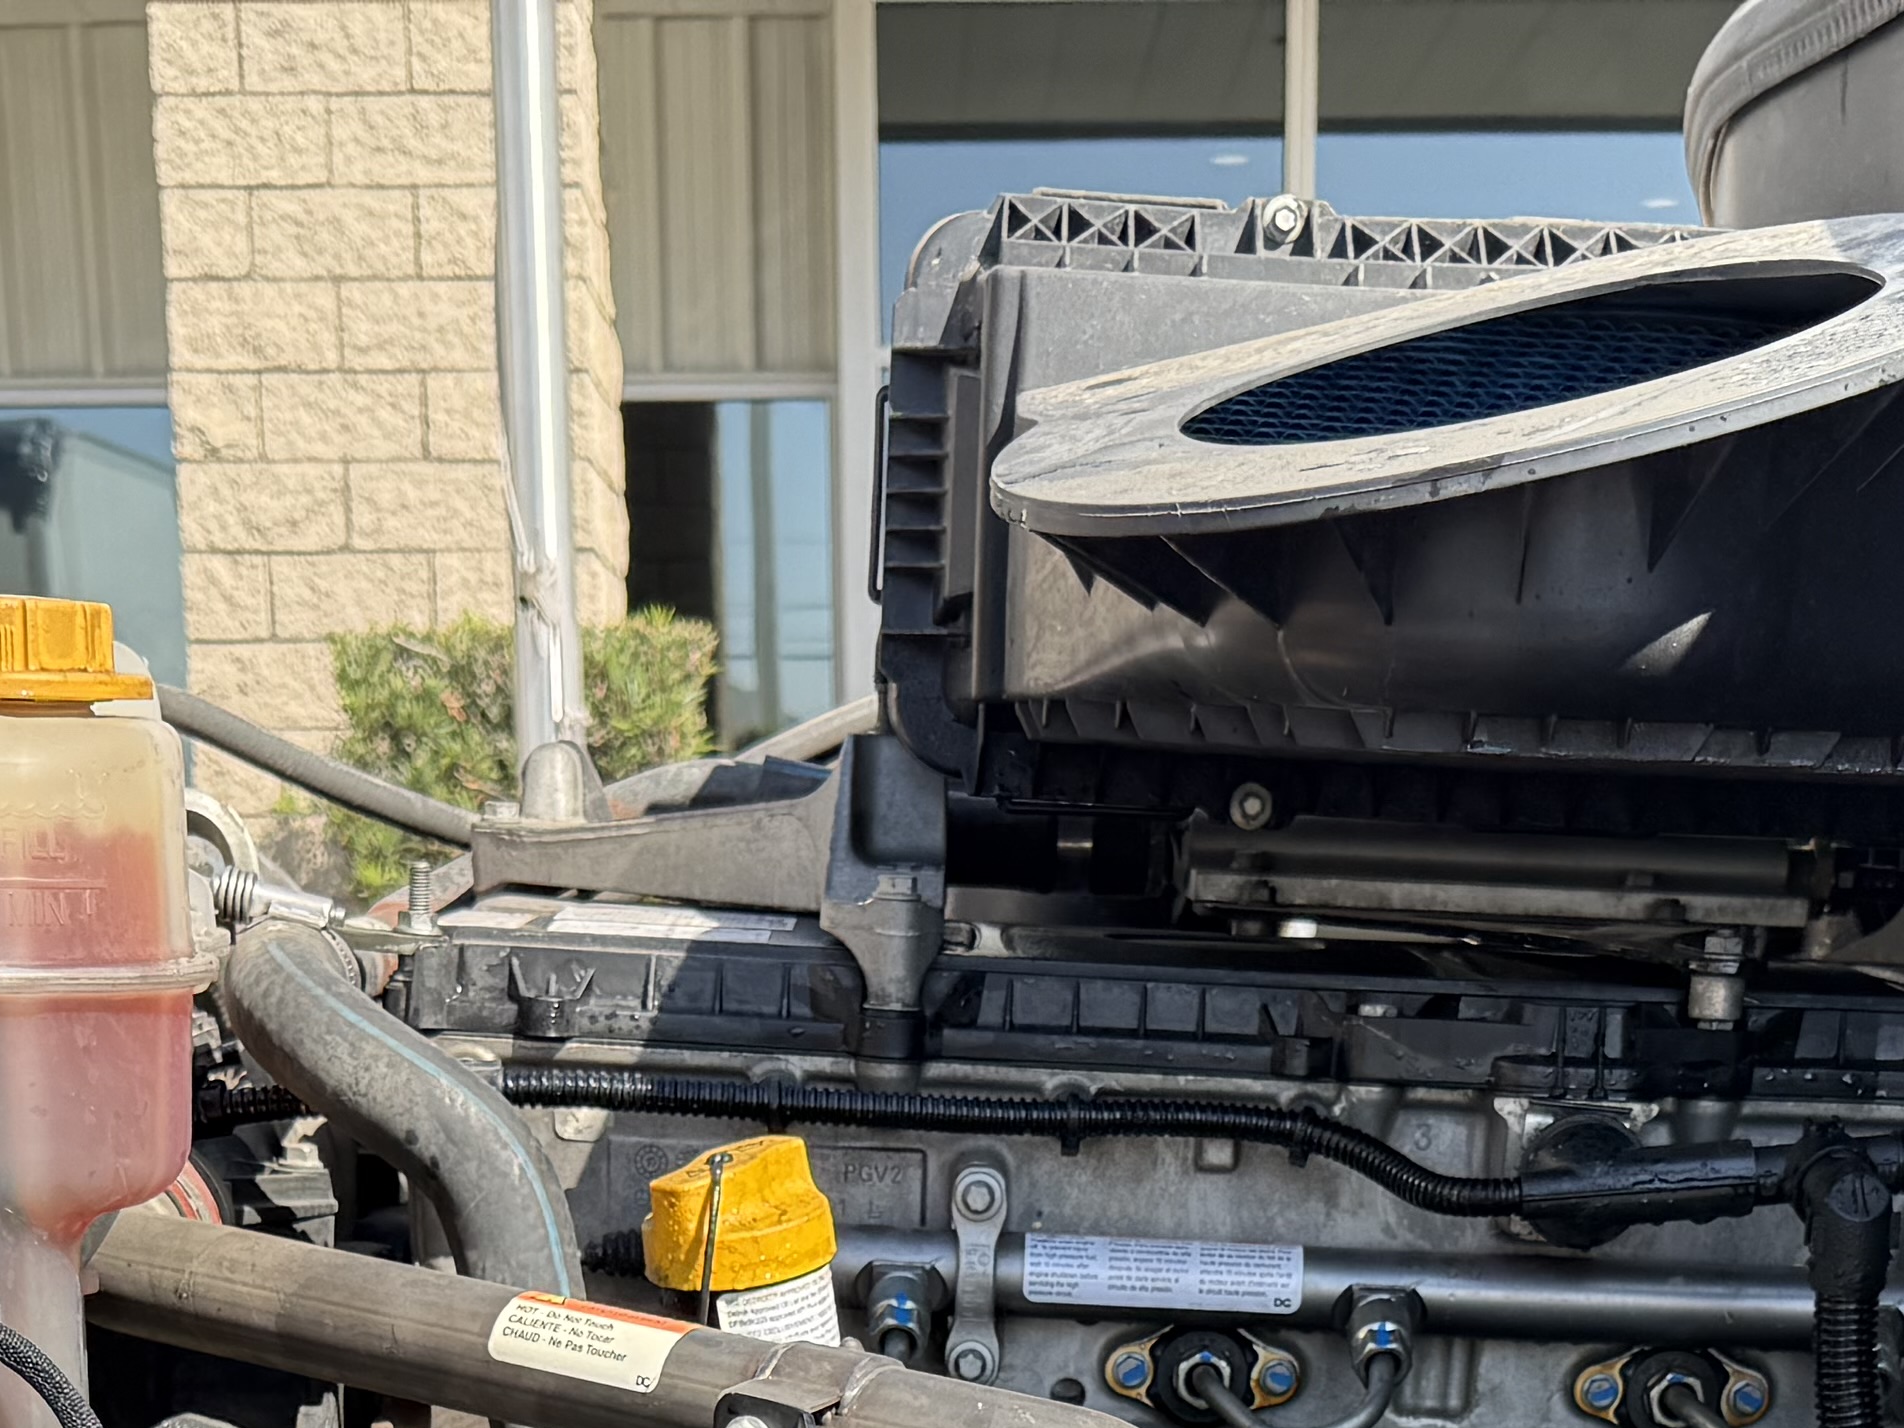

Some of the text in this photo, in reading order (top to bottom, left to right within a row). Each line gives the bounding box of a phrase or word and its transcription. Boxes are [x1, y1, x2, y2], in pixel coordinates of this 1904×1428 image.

[1, 825, 65, 861] FILL
[9, 891, 67, 926] MIN
[844, 1165, 902, 1185] PGV2
[1274, 1298, 1291, 1308] DC
[508, 1315, 615, 1344] CALIENTE No Tocar
[516, 1304, 538, 1314] HOT
[546, 1310, 561, 1320] Do
[565, 1314, 582, 1324] Not
[585, 1318, 614, 1331] Touch
[503, 1326, 627, 1362] CHAUD Ne Pas Toucher
[636, 1375, 650, 1387] DC
